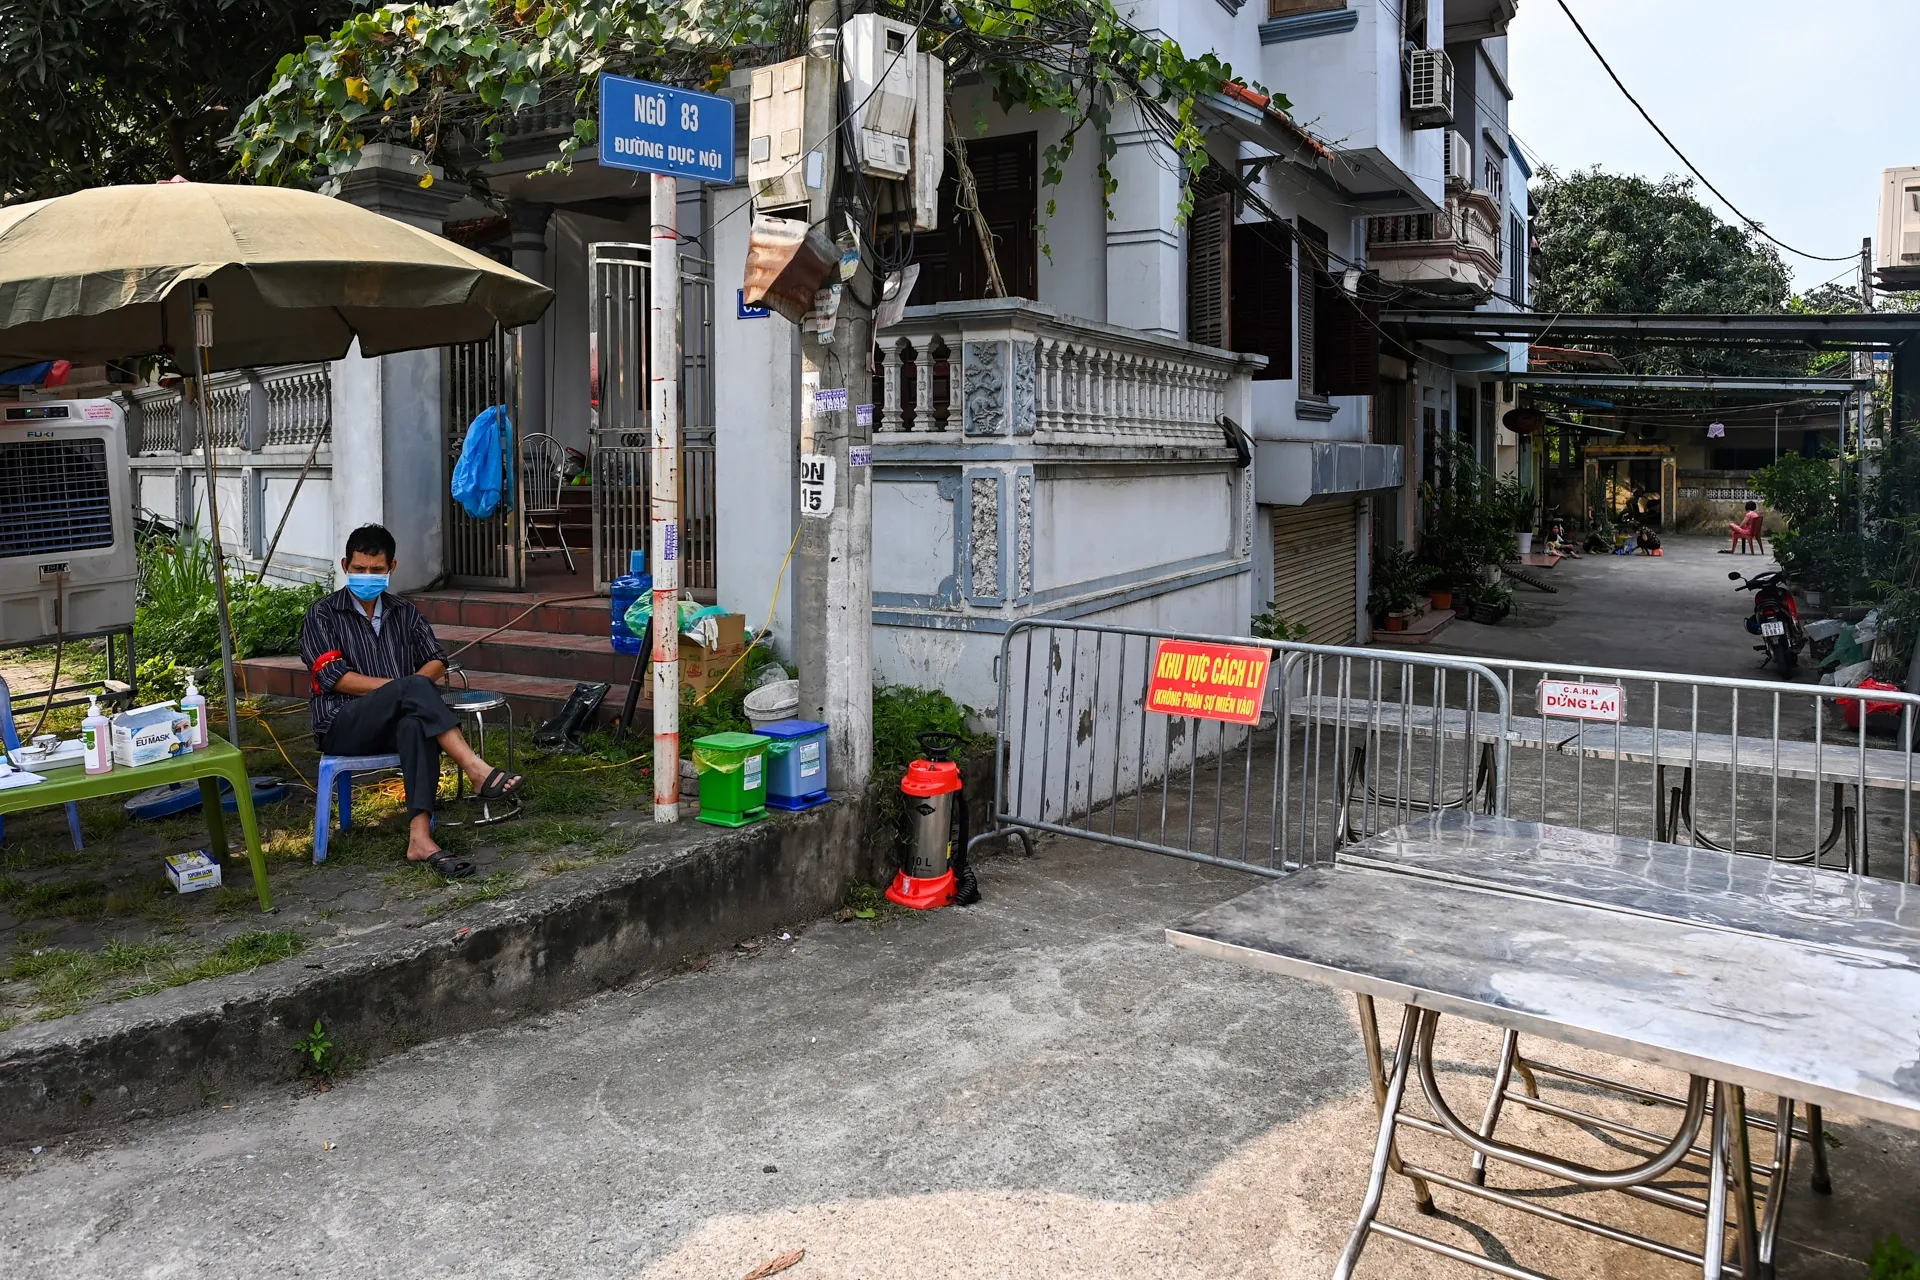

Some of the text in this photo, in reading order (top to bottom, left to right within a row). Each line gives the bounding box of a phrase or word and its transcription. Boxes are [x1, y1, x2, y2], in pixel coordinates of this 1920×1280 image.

[634, 93, 698, 132] NGÕ 83
[614, 136, 722, 171] ĐƯỜNG DỤC NỘI
[802, 488, 822, 510] 15
[1157, 652, 1264, 688] KHU VỰC CÁCH LY
[1153, 687, 1255, 717] (KHÔNG PHẬN SỰ MIỄN VÀO)
[1563, 687, 1598, 695] C.A.H.N
[1547, 693, 1615, 713] DỪNG LẠI
[136, 738, 148, 747] EU
[148, 733, 170, 744] MASK
[926, 858, 932, 867] L
